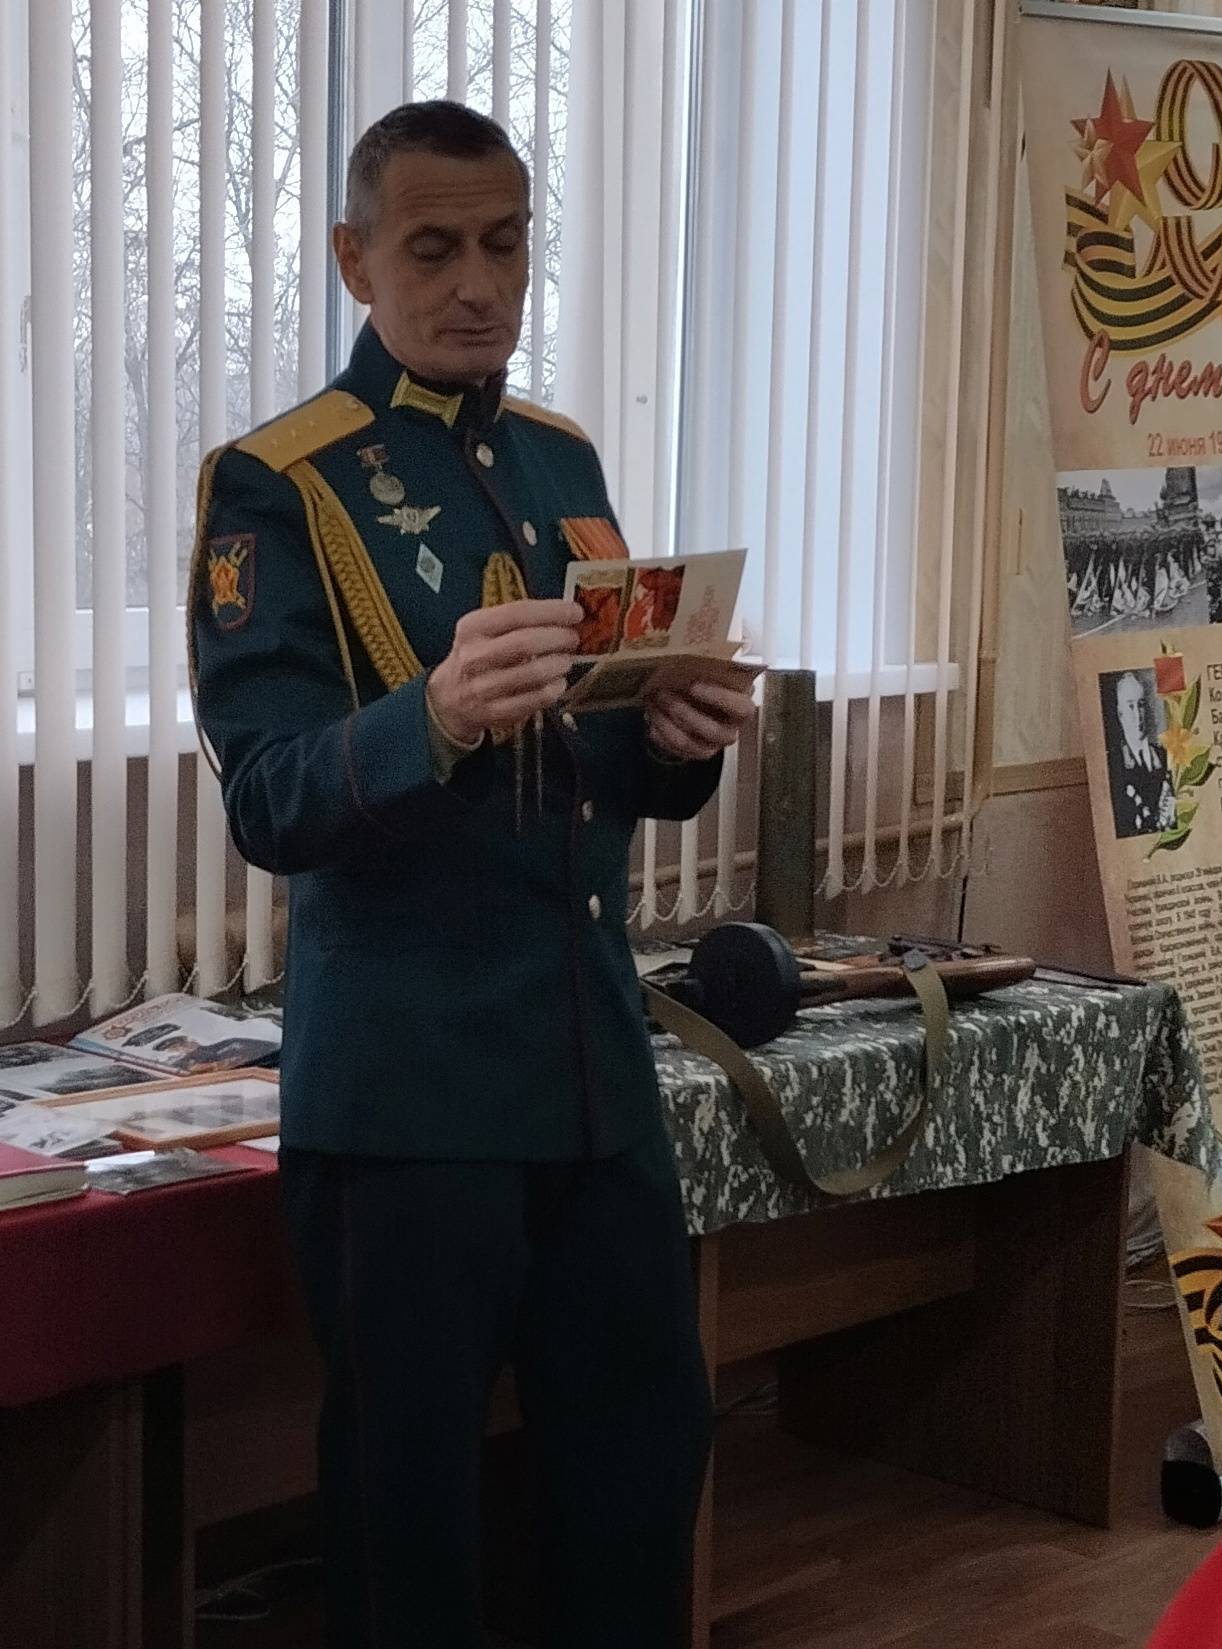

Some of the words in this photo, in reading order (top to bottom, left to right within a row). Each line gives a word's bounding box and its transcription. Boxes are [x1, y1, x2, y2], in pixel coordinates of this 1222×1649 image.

[1080, 330, 1111, 413] С
[1147, 432, 1163, 457] 22
[1167, 437, 1206, 456] июня
